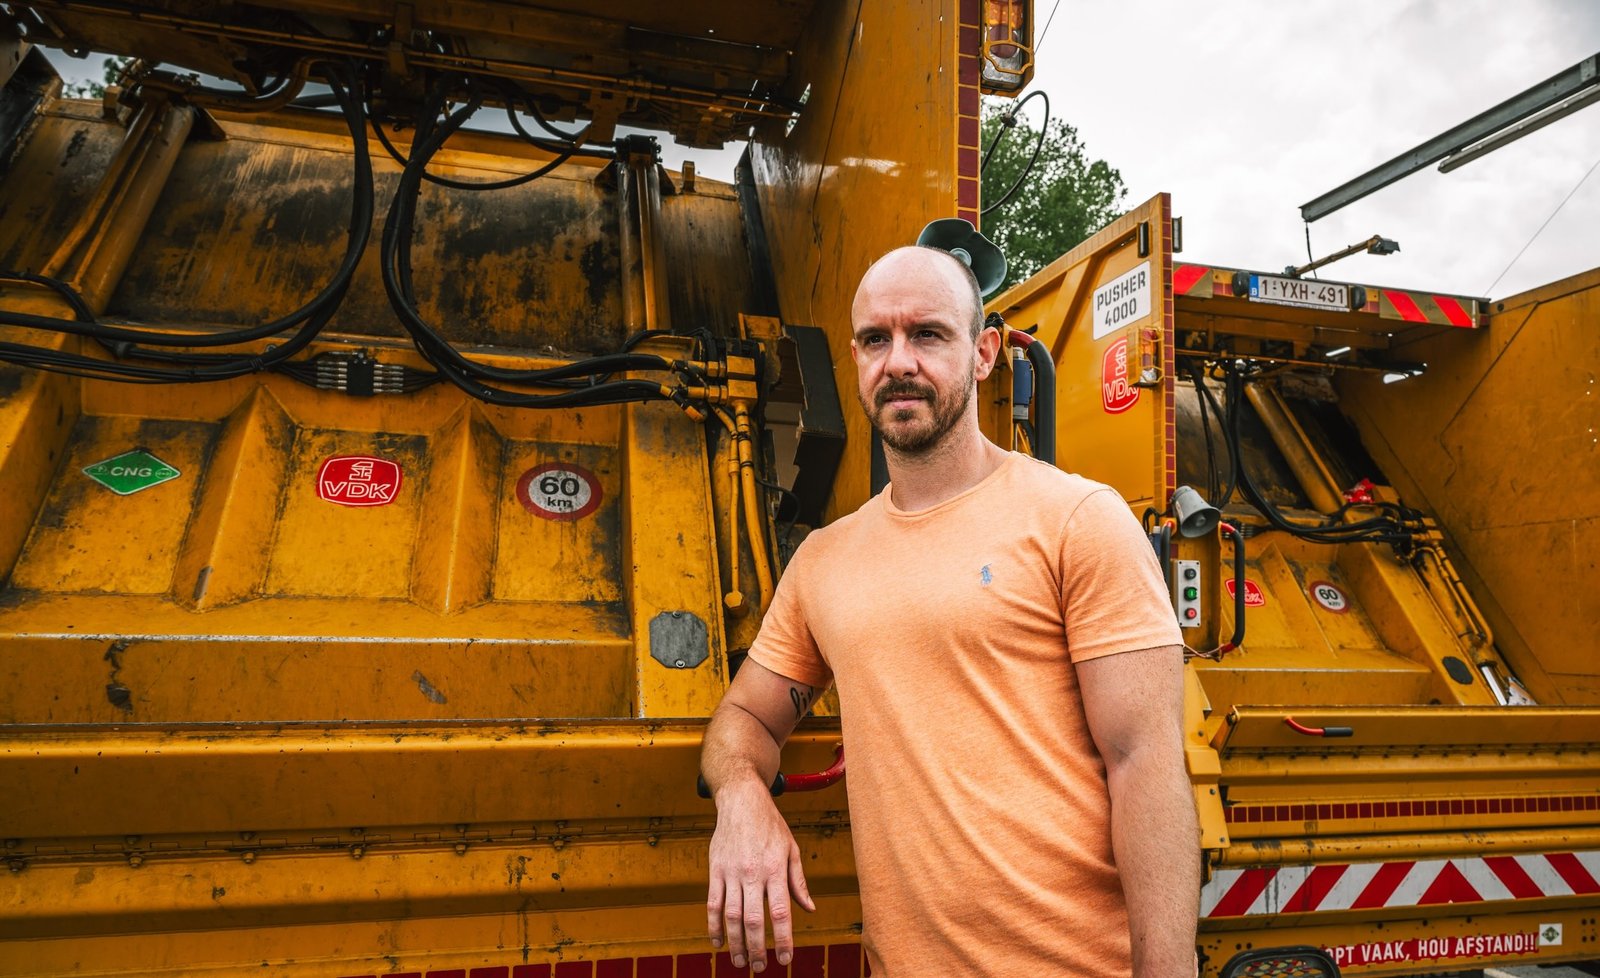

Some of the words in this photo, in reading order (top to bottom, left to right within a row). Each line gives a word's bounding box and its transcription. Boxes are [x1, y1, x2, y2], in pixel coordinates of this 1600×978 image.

[1097, 270, 1146, 311] PUSHER
[1251, 287, 1258, 296] B
[1104, 297, 1137, 327] 4000
[110, 466, 153, 478] CNG
[324, 480, 391, 500] VDK
[540, 476, 580, 496] 60
[547, 496, 573, 508] km
[1318, 588, 1338, 600] 60
[1361, 941, 1411, 962] VAAK,
[1418, 938, 1448, 957] HOU
[1455, 934, 1534, 955] AFSTAND!!
